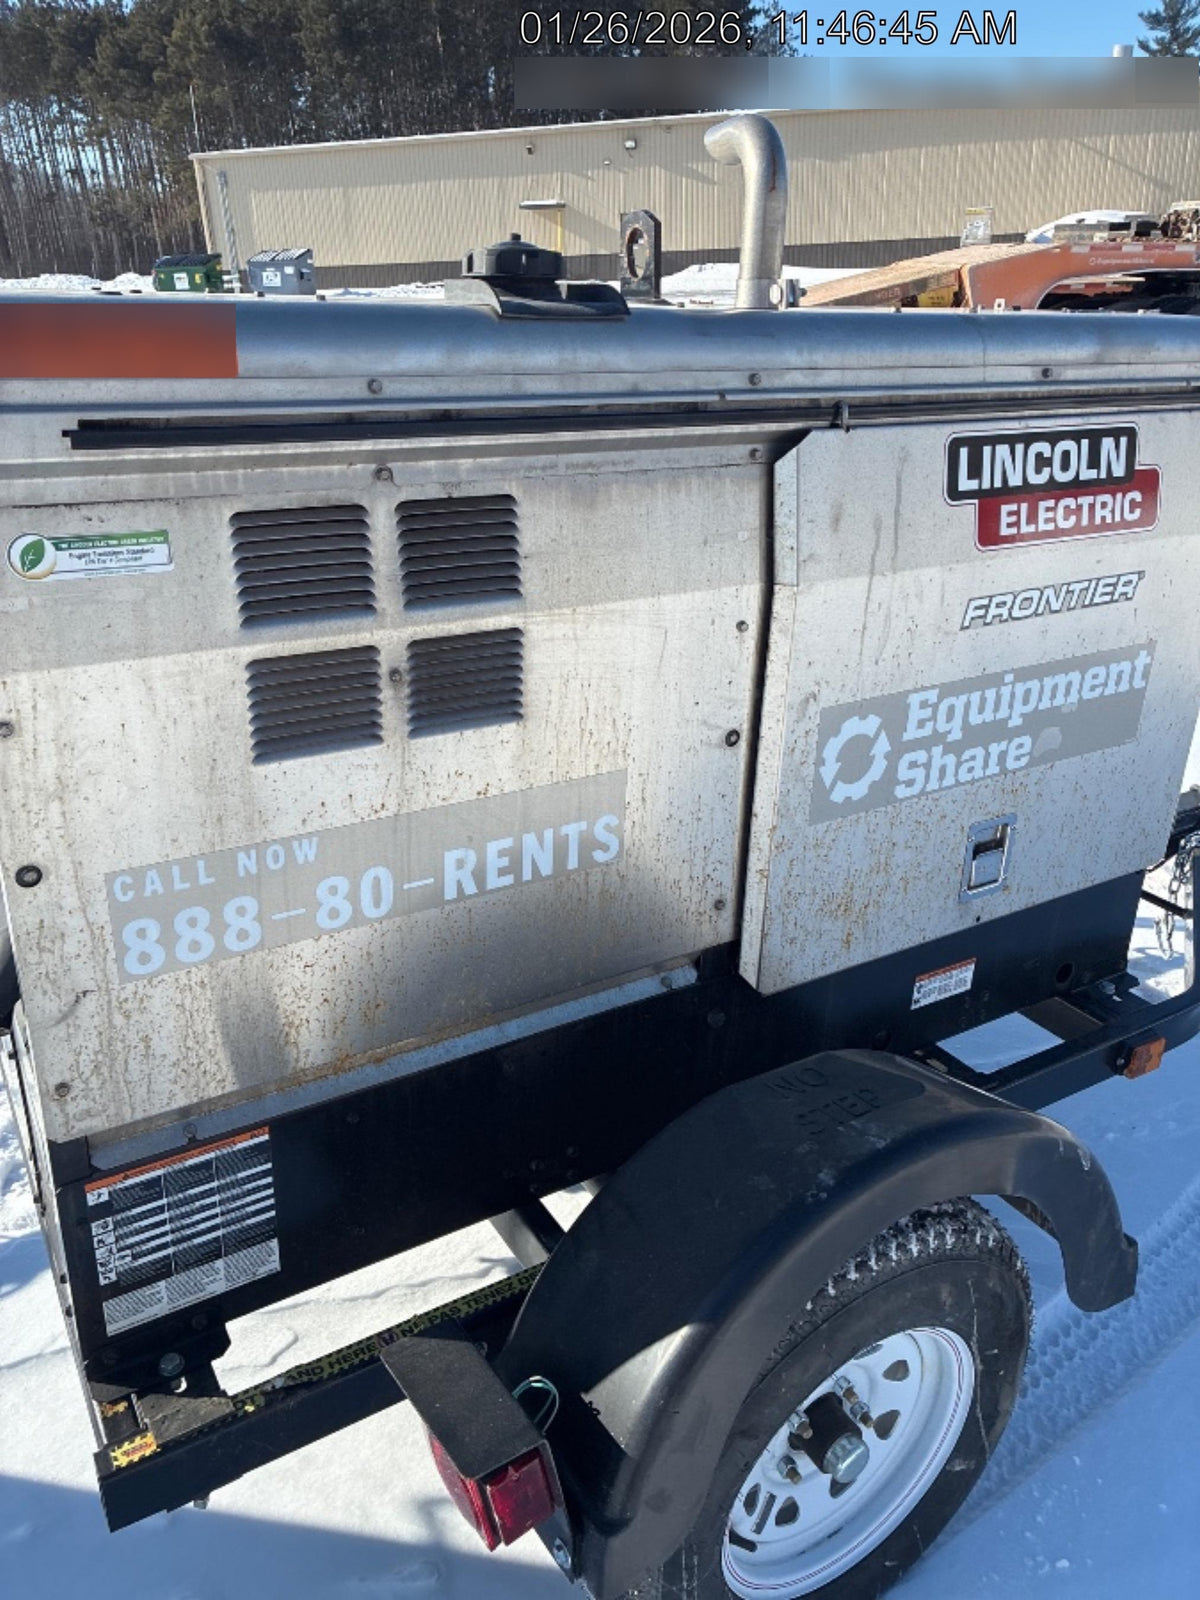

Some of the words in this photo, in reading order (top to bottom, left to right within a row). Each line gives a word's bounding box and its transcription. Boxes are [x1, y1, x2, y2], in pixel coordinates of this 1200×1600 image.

[957, 436, 1128, 492] LINCOLN
[1000, 490, 1142, 536] ELECTRIC
[961, 571, 1144, 630] FRONTIER
[902, 650, 1151, 742] Equipment
[894, 735, 1032, 799] Share
[113, 860, 216, 902] CALL
[236, 837, 320, 878] NOW
